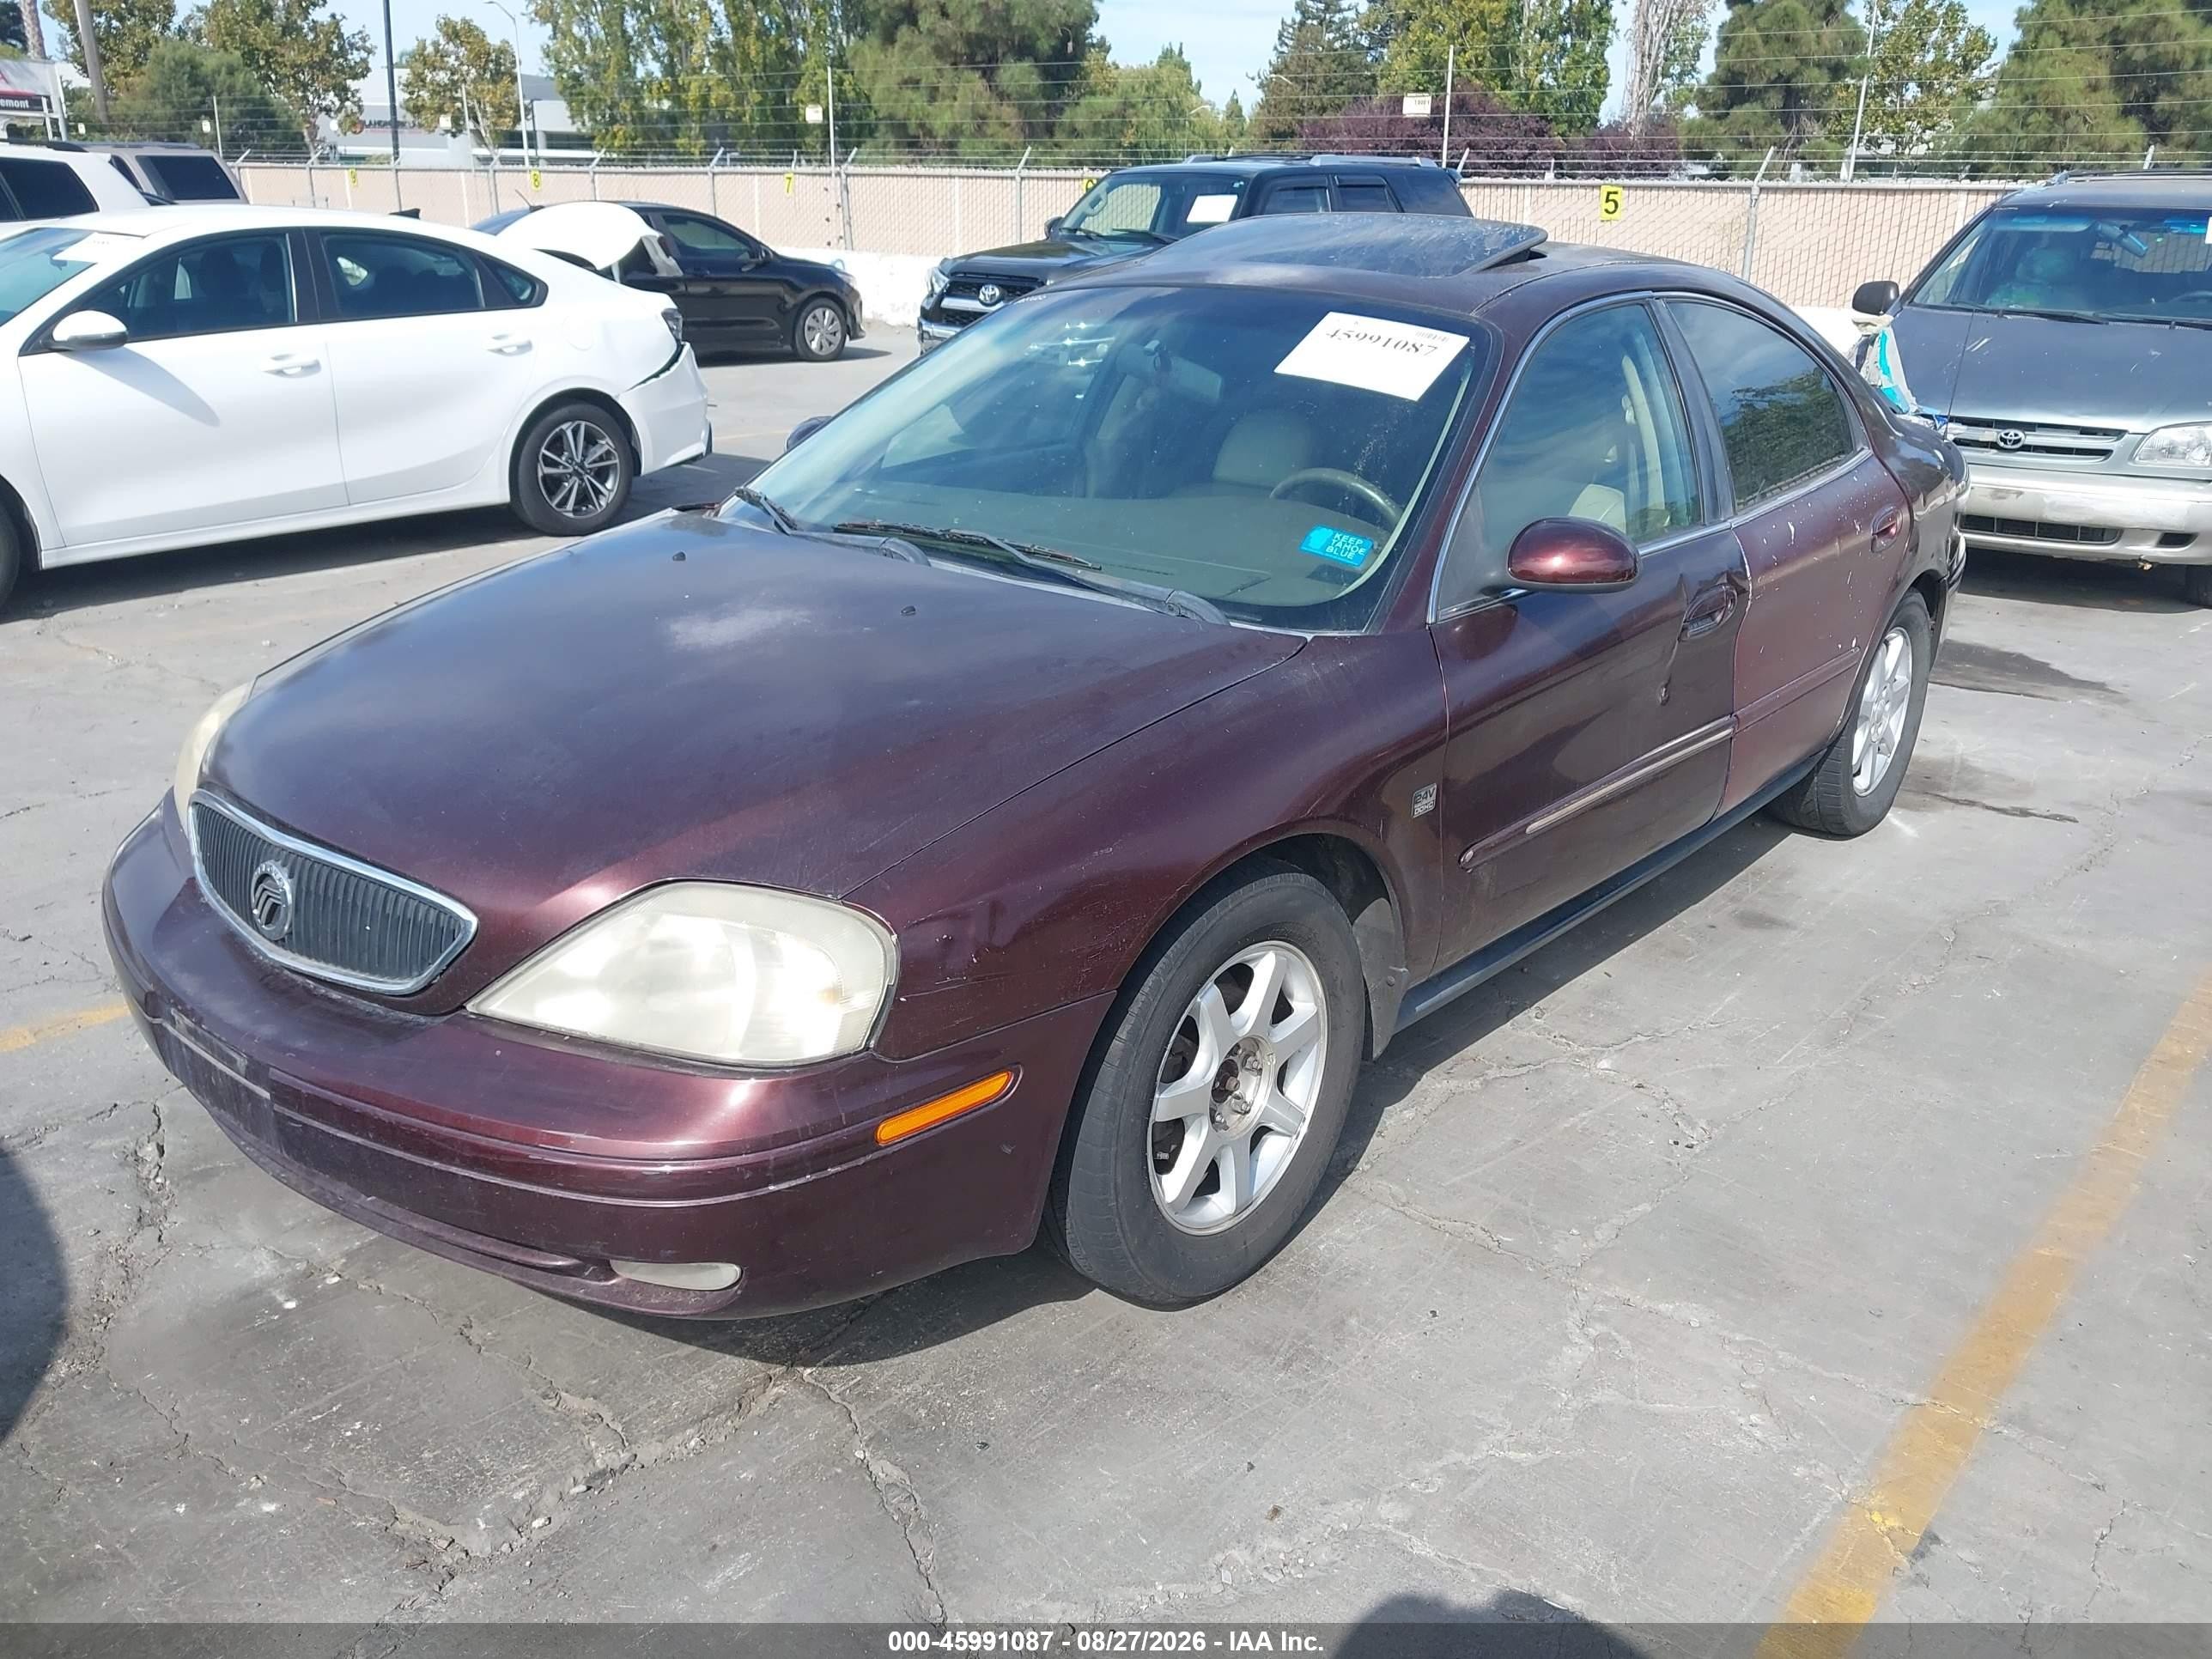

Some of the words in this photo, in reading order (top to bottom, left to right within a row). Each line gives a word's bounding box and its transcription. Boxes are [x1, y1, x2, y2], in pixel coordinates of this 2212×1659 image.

[532, 173, 540, 188] 8
[785, 176, 793, 193] 7
[1603, 191, 1619, 215] 5
[1325, 329, 1438, 356] 45991087
[1334, 532, 1364, 545] KEEP
[1326, 545, 1355, 560] BLUE
[1332, 539, 1367, 556] TAHOE
[1415, 787, 1435, 804] 24V
